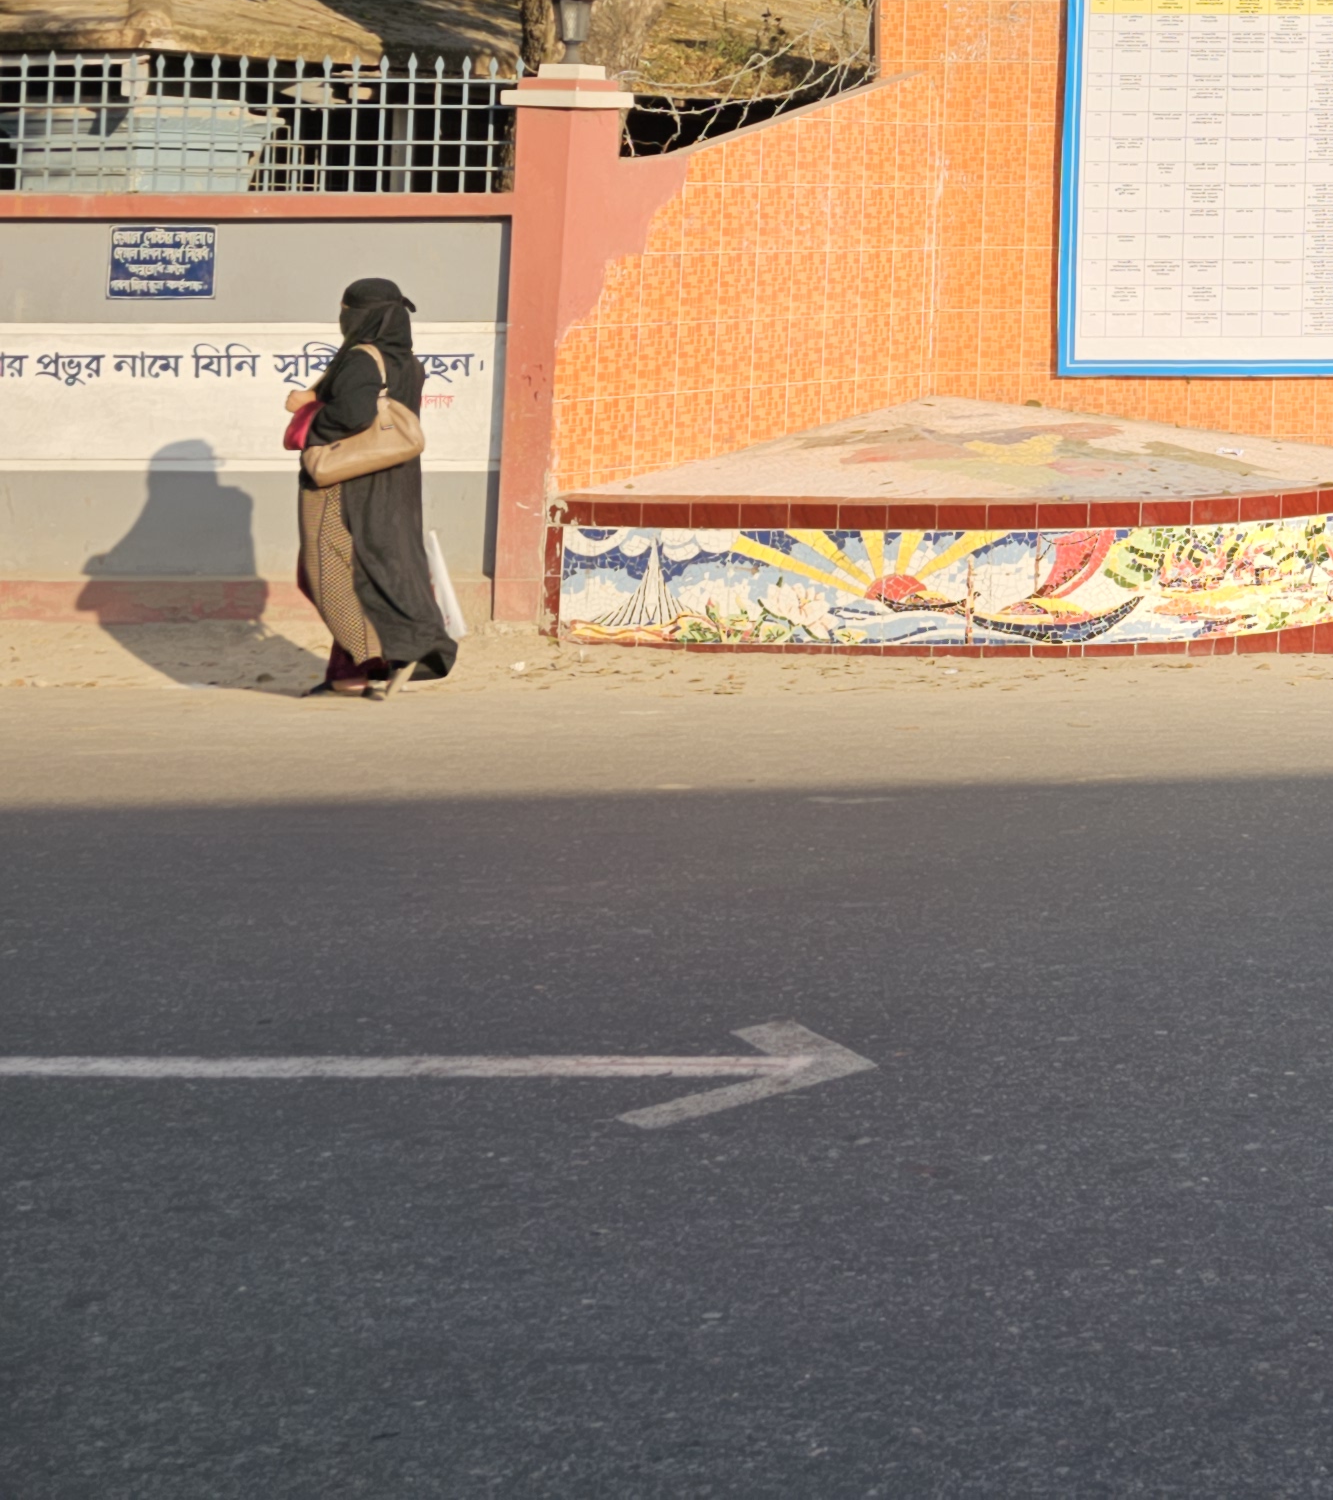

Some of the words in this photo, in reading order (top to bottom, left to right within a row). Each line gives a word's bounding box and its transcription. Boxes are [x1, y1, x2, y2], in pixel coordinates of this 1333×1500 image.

[35, 351, 106, 386] প্রভুর
[113, 351, 184, 378] নামে
[191, 342, 261, 378] যিনি
